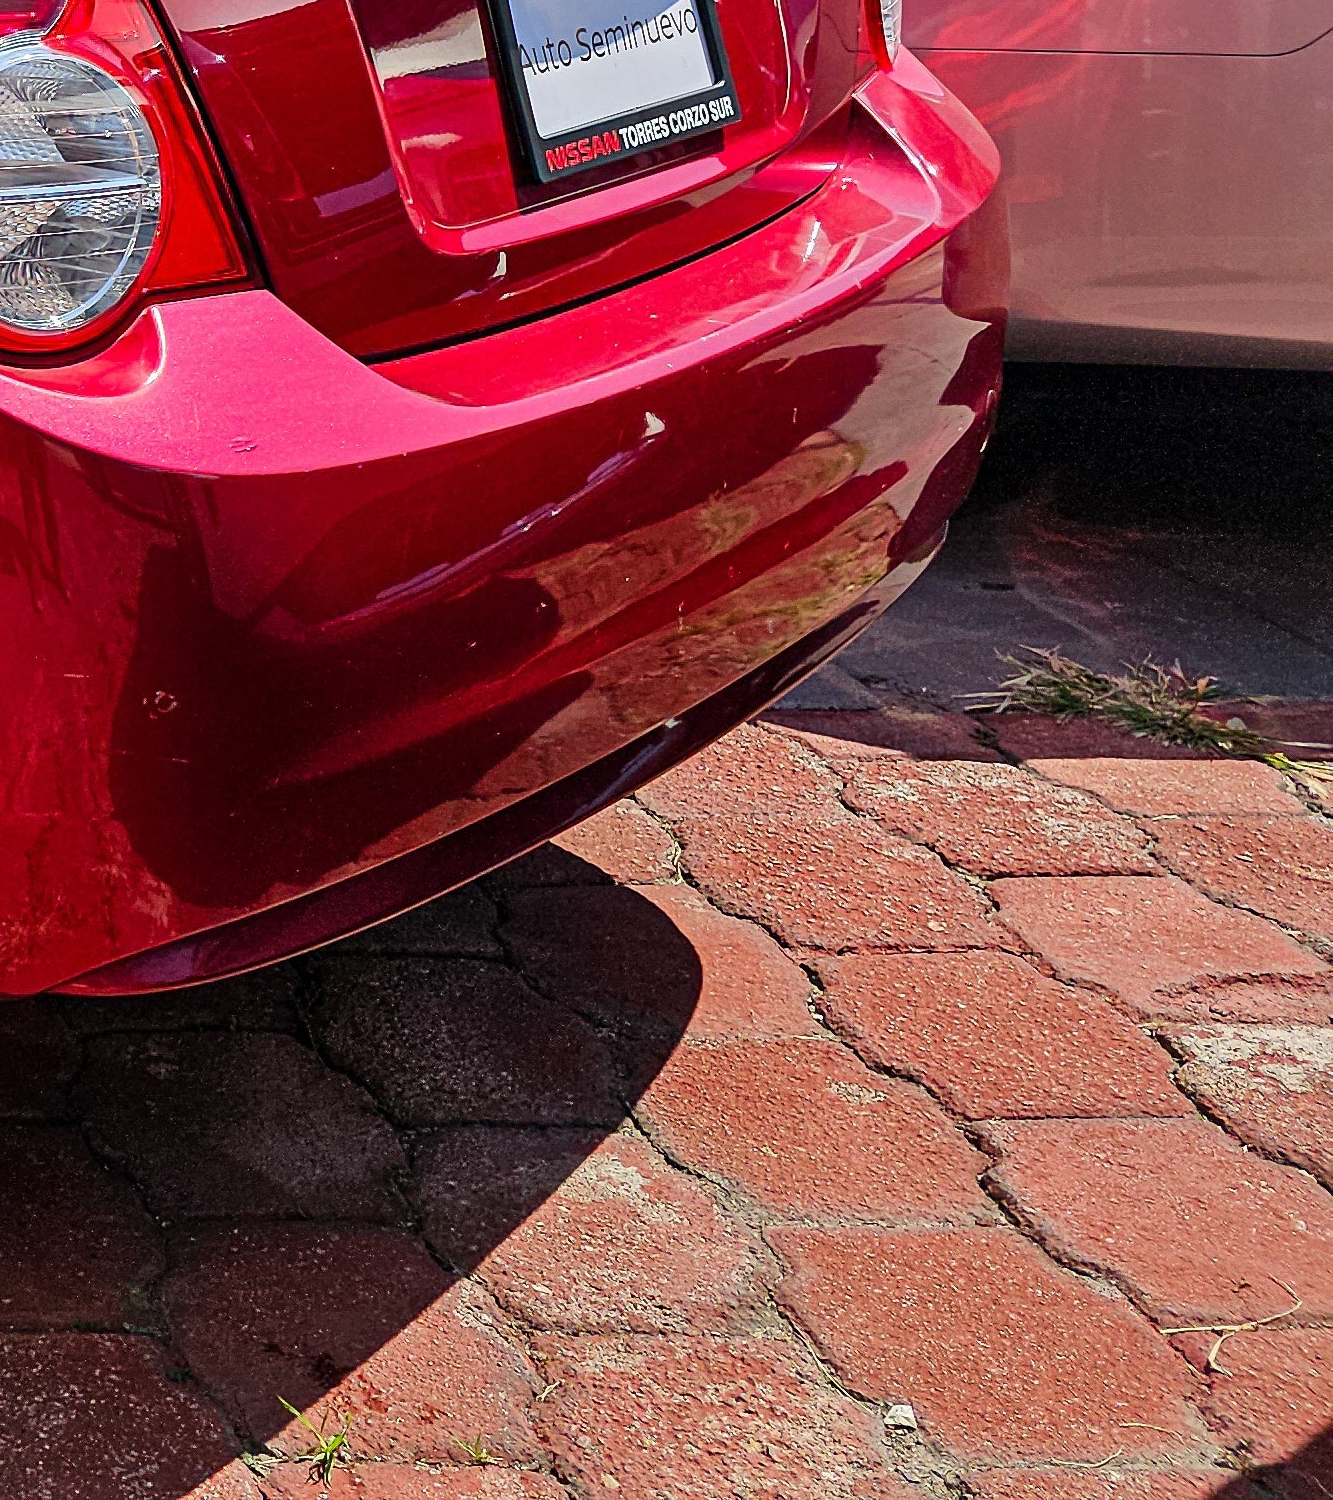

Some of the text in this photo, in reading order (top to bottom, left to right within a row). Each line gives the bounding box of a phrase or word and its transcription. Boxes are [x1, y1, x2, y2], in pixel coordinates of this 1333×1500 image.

[518, 8, 698, 76] Auto Seminuevo
[544, 96, 734, 173] NISSAN TORRES CORZO SUR
